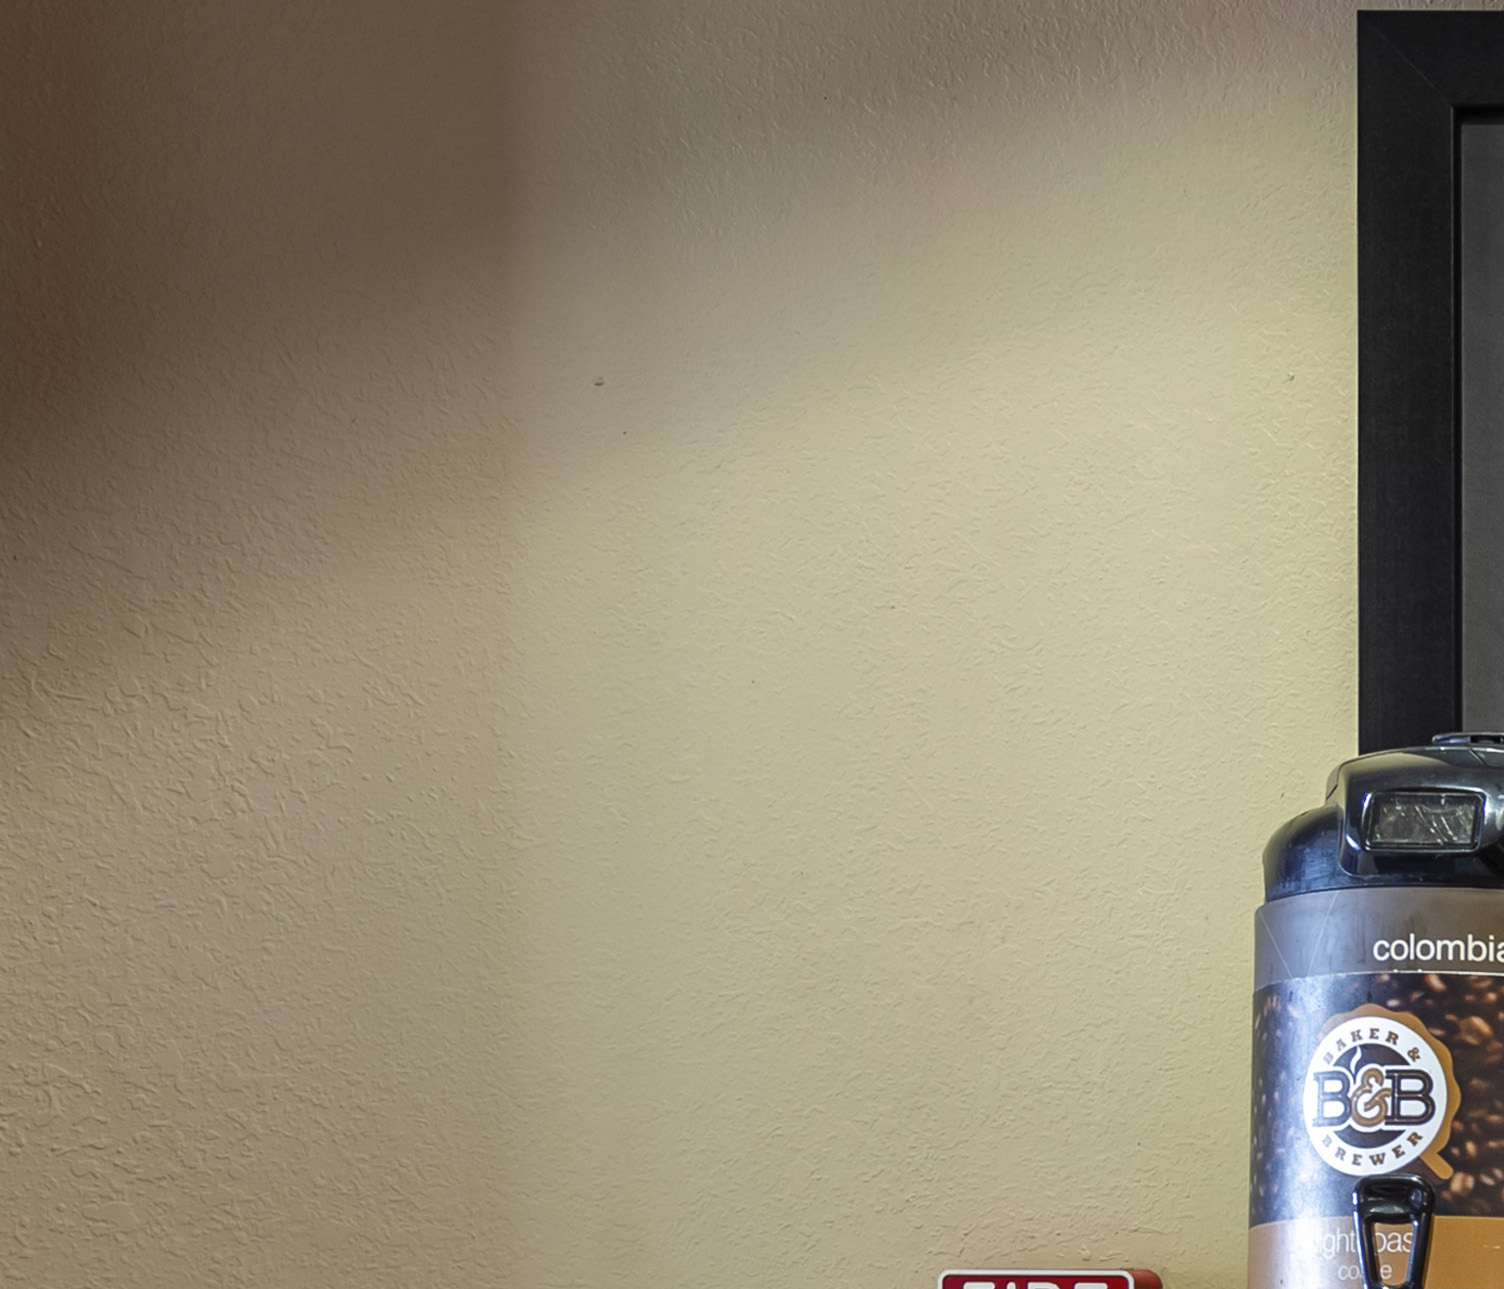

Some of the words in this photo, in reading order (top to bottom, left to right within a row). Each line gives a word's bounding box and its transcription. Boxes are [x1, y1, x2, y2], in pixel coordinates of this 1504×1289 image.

[1323, 1027, 1400, 1065] BAKER
[1407, 1047, 1422, 1062] &
[1312, 1067, 1436, 1128] B&B
[1321, 1131, 1423, 1167] BREWER
